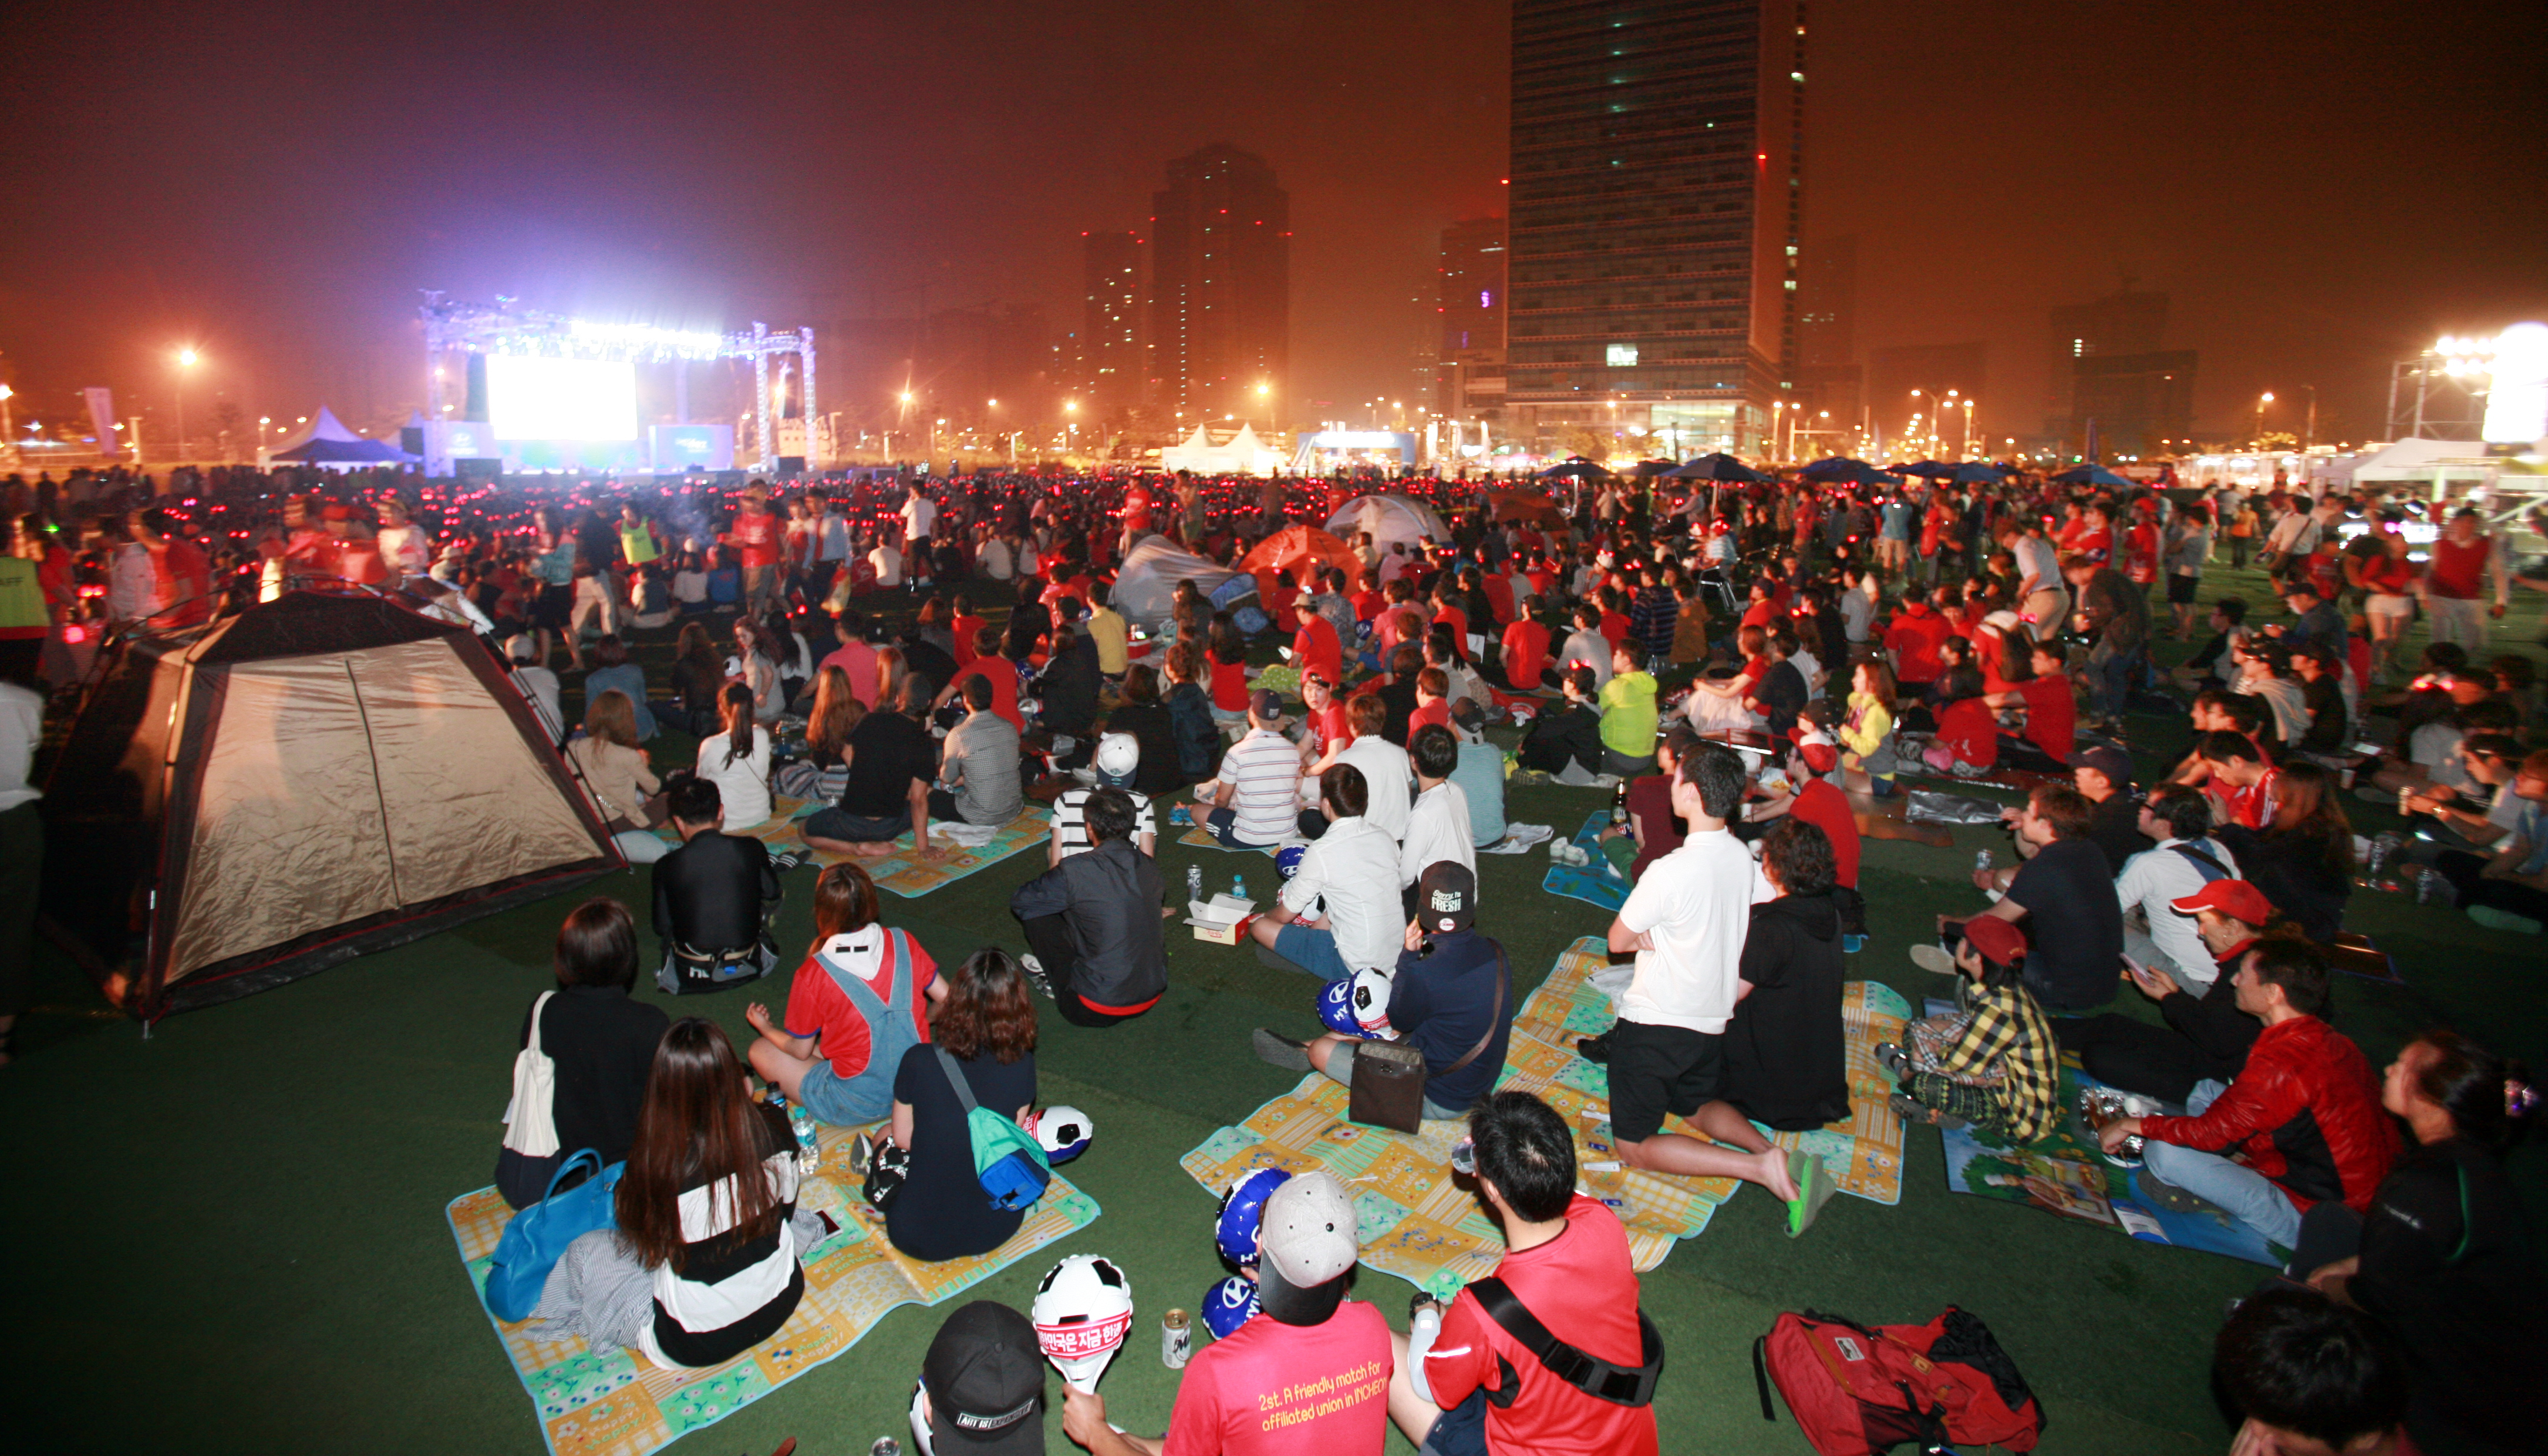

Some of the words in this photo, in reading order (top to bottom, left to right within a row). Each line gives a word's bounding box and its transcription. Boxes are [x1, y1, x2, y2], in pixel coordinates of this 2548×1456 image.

[1431, 896, 1461, 912] FRESH
[794, 1333, 844, 1364] Happy!
[1039, 1331, 1071, 1352] 한민국은
[1078, 1328, 1096, 1349] 지금
[1258, 1391, 1283, 1411] 2st.
[1283, 1387, 1293, 1404] A
[1294, 1376, 1334, 1401] friendly
[1336, 1364, 1367, 1388] match
[1367, 1361, 1381, 1377] for
[960, 1417, 978, 1427] ART
[979, 1419, 989, 1428] IS
[1262, 1403, 1315, 1431] affiliated
[1316, 1398, 1344, 1417] union
[1344, 1393, 1354, 1408] in
[585, 1412, 646, 1450] Happy!
